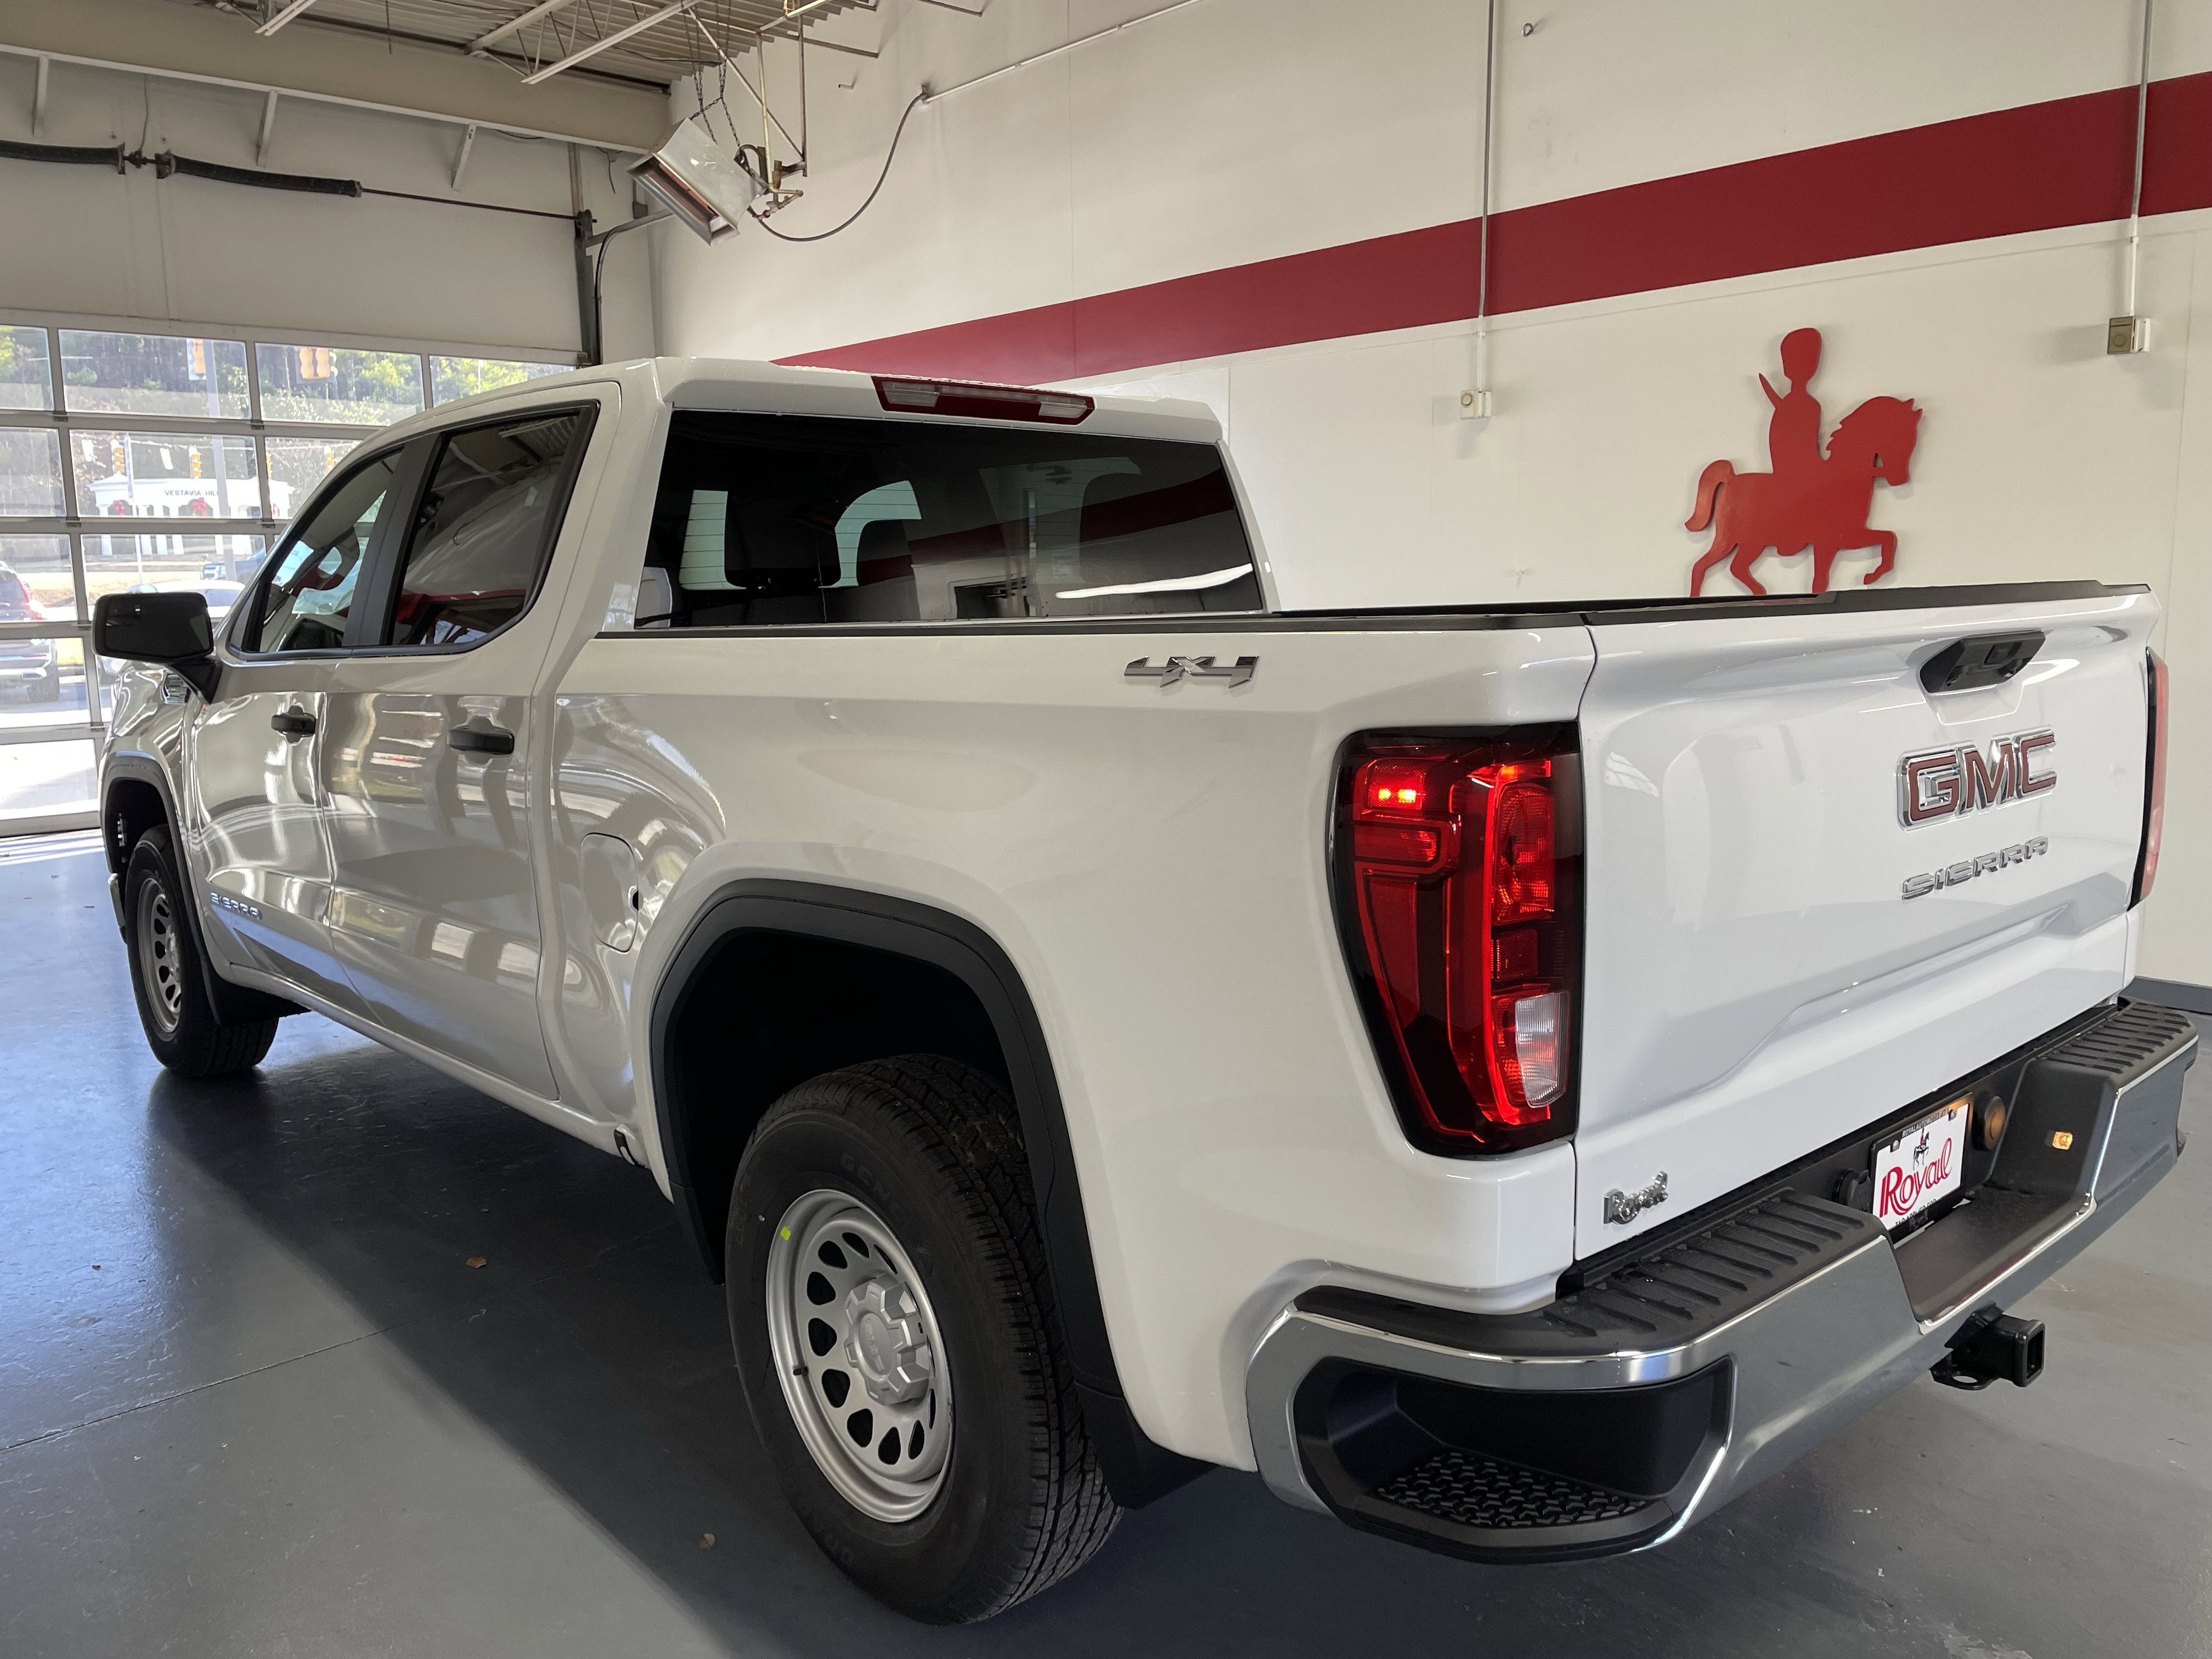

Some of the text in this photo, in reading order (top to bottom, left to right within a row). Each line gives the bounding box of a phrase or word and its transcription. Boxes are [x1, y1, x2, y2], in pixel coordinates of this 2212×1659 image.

[1896, 728, 2057, 830] GMC
[1901, 836, 2049, 900] SIERRA
[1879, 1137, 1953, 1218] Royal
